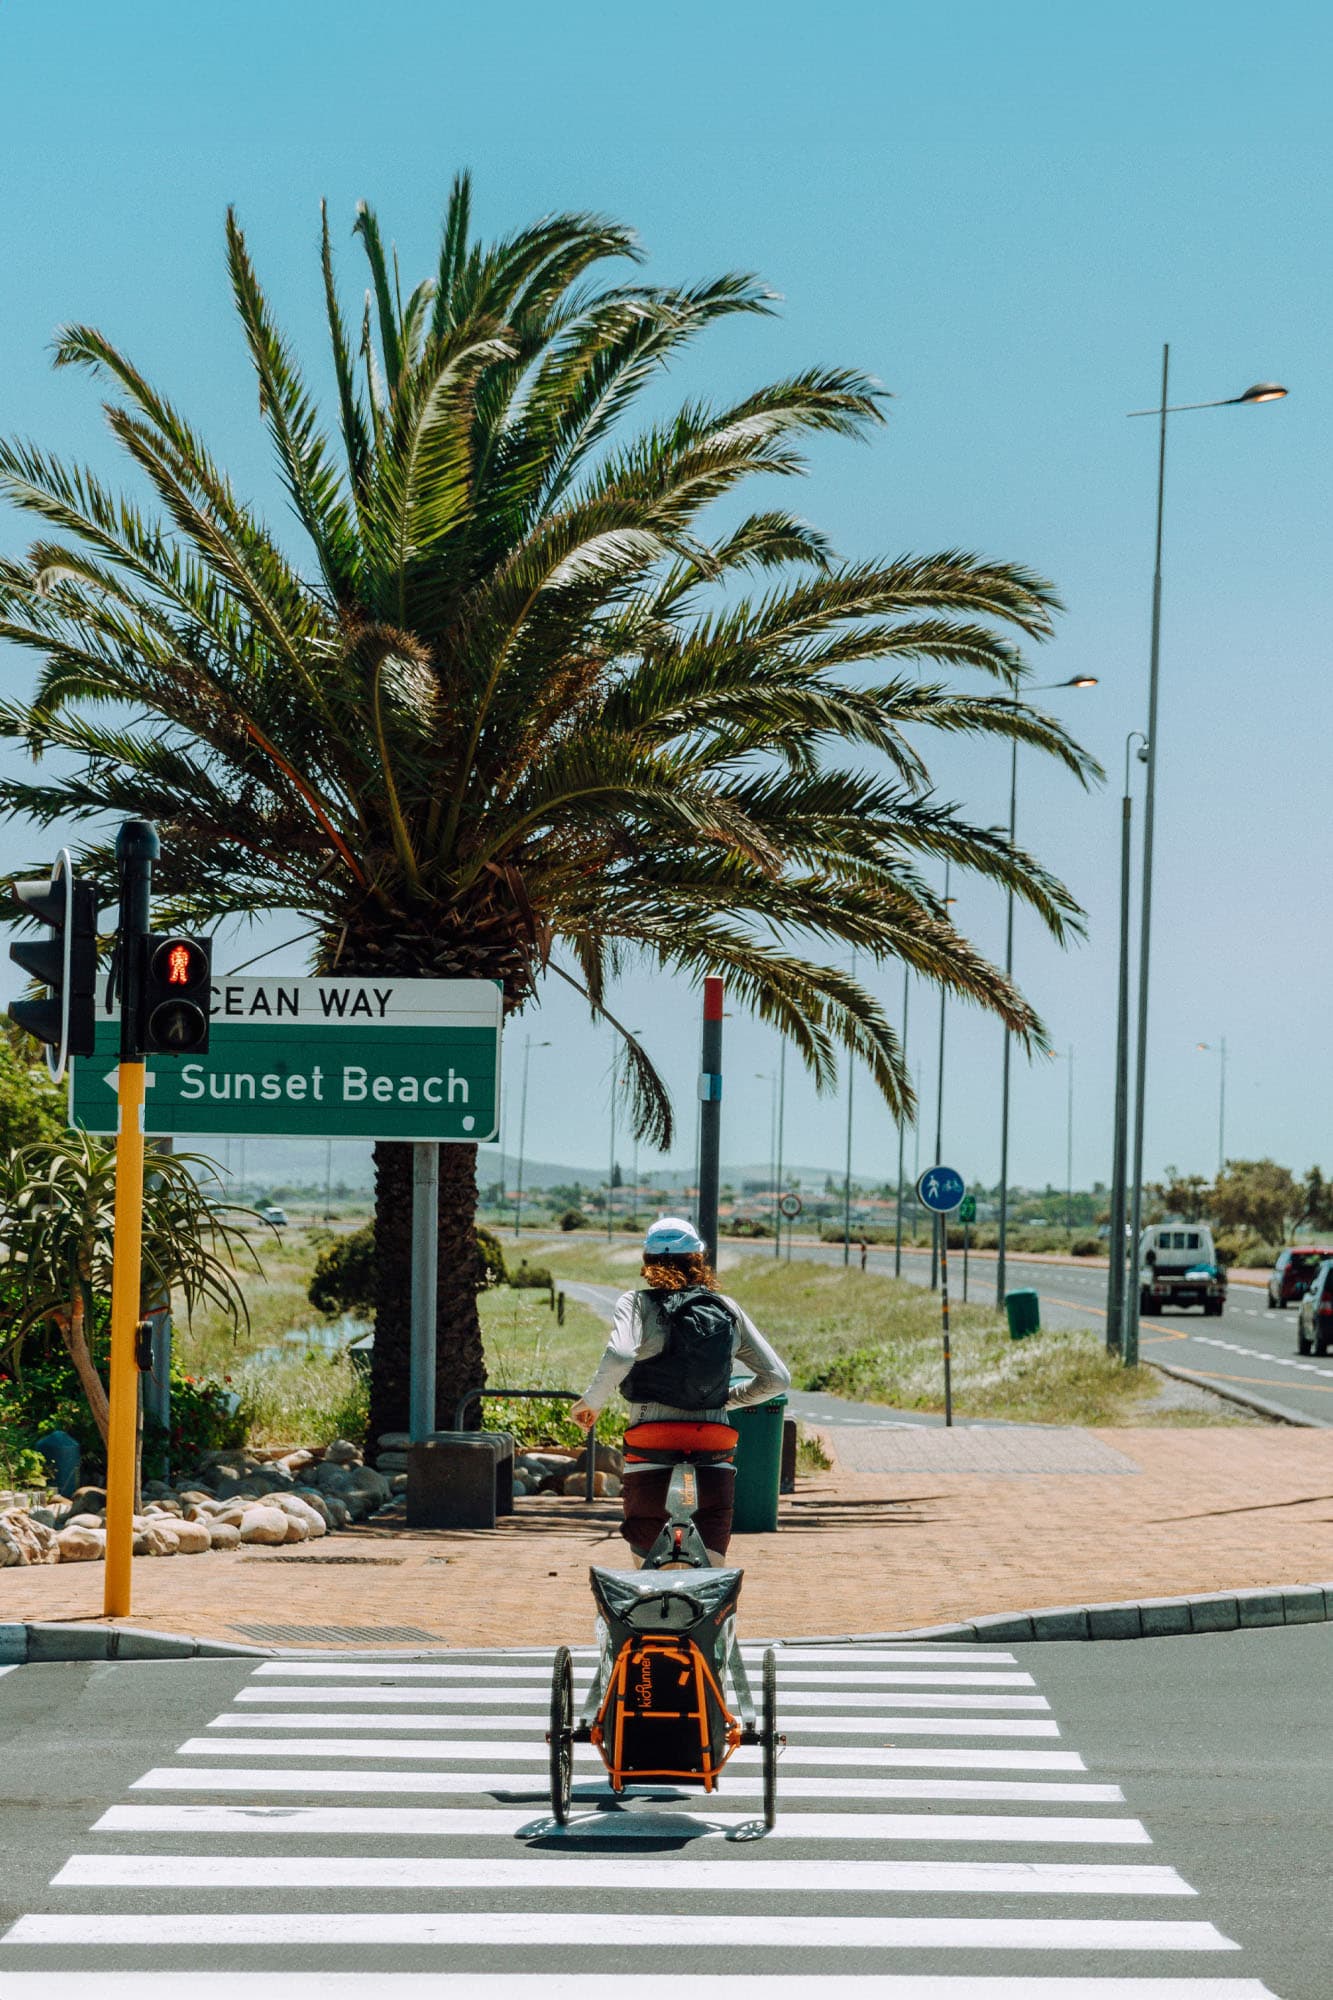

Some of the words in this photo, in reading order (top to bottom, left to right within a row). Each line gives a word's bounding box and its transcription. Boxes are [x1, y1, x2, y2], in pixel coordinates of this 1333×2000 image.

[209, 986, 299, 1017] CEAN
[319, 988, 393, 1018] WAY
[180, 1063, 324, 1101] Sunset
[343, 1066, 469, 1104] Beach
